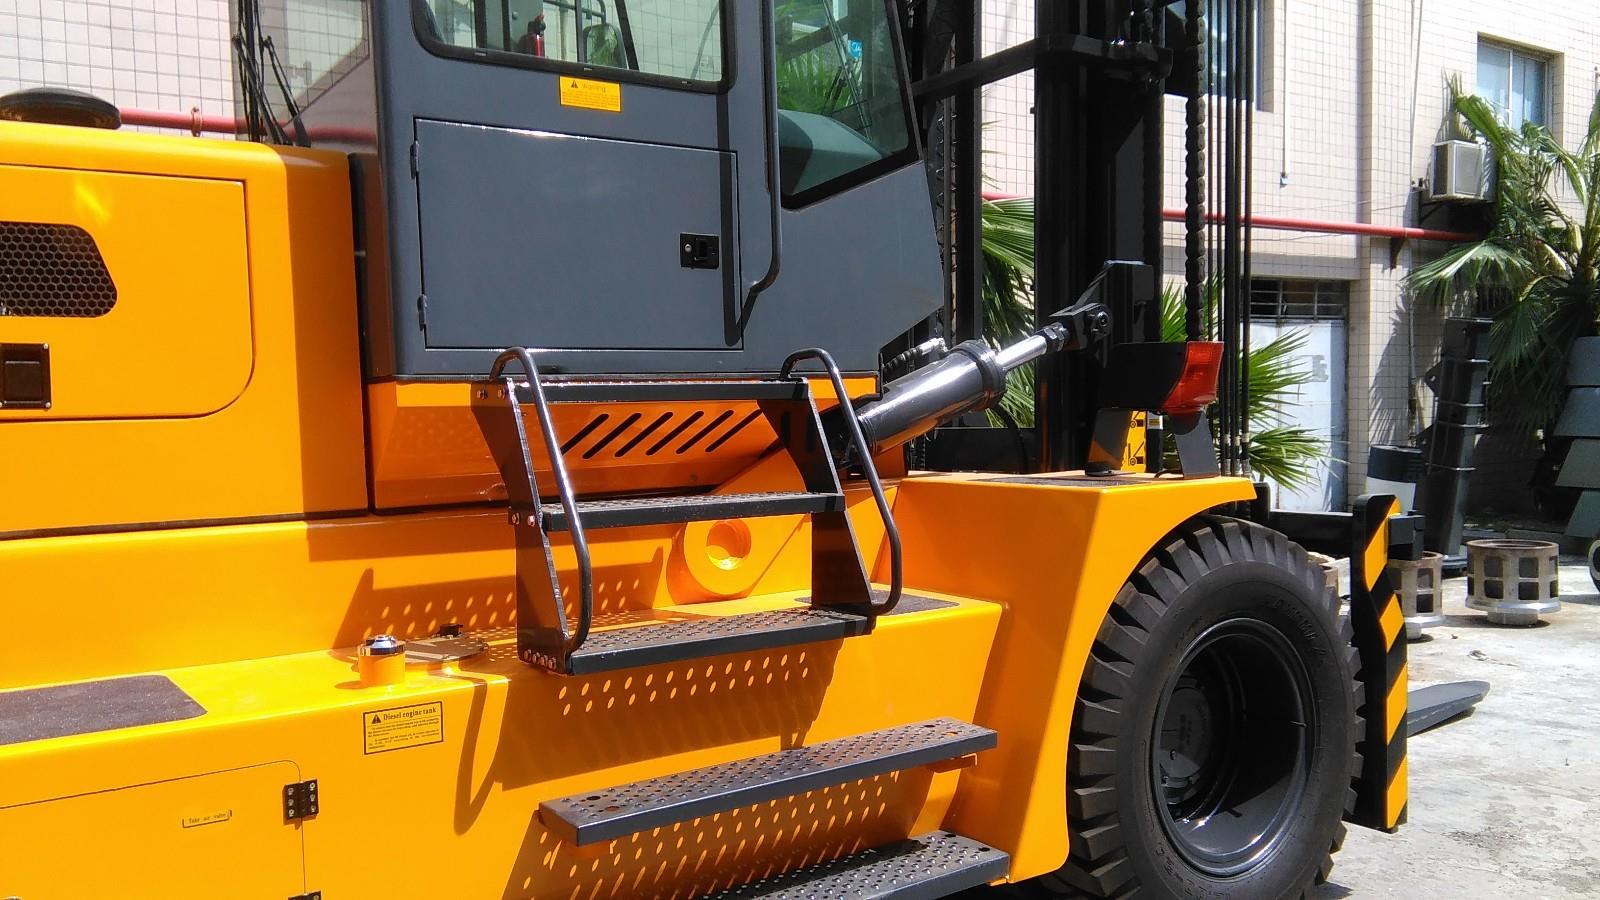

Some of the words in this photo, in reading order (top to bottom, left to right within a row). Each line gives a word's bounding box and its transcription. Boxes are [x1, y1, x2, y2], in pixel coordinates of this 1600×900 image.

[383, 711, 402, 721] Diesel
[402, 708, 422, 718] engine
[423, 706, 437, 714] tank
